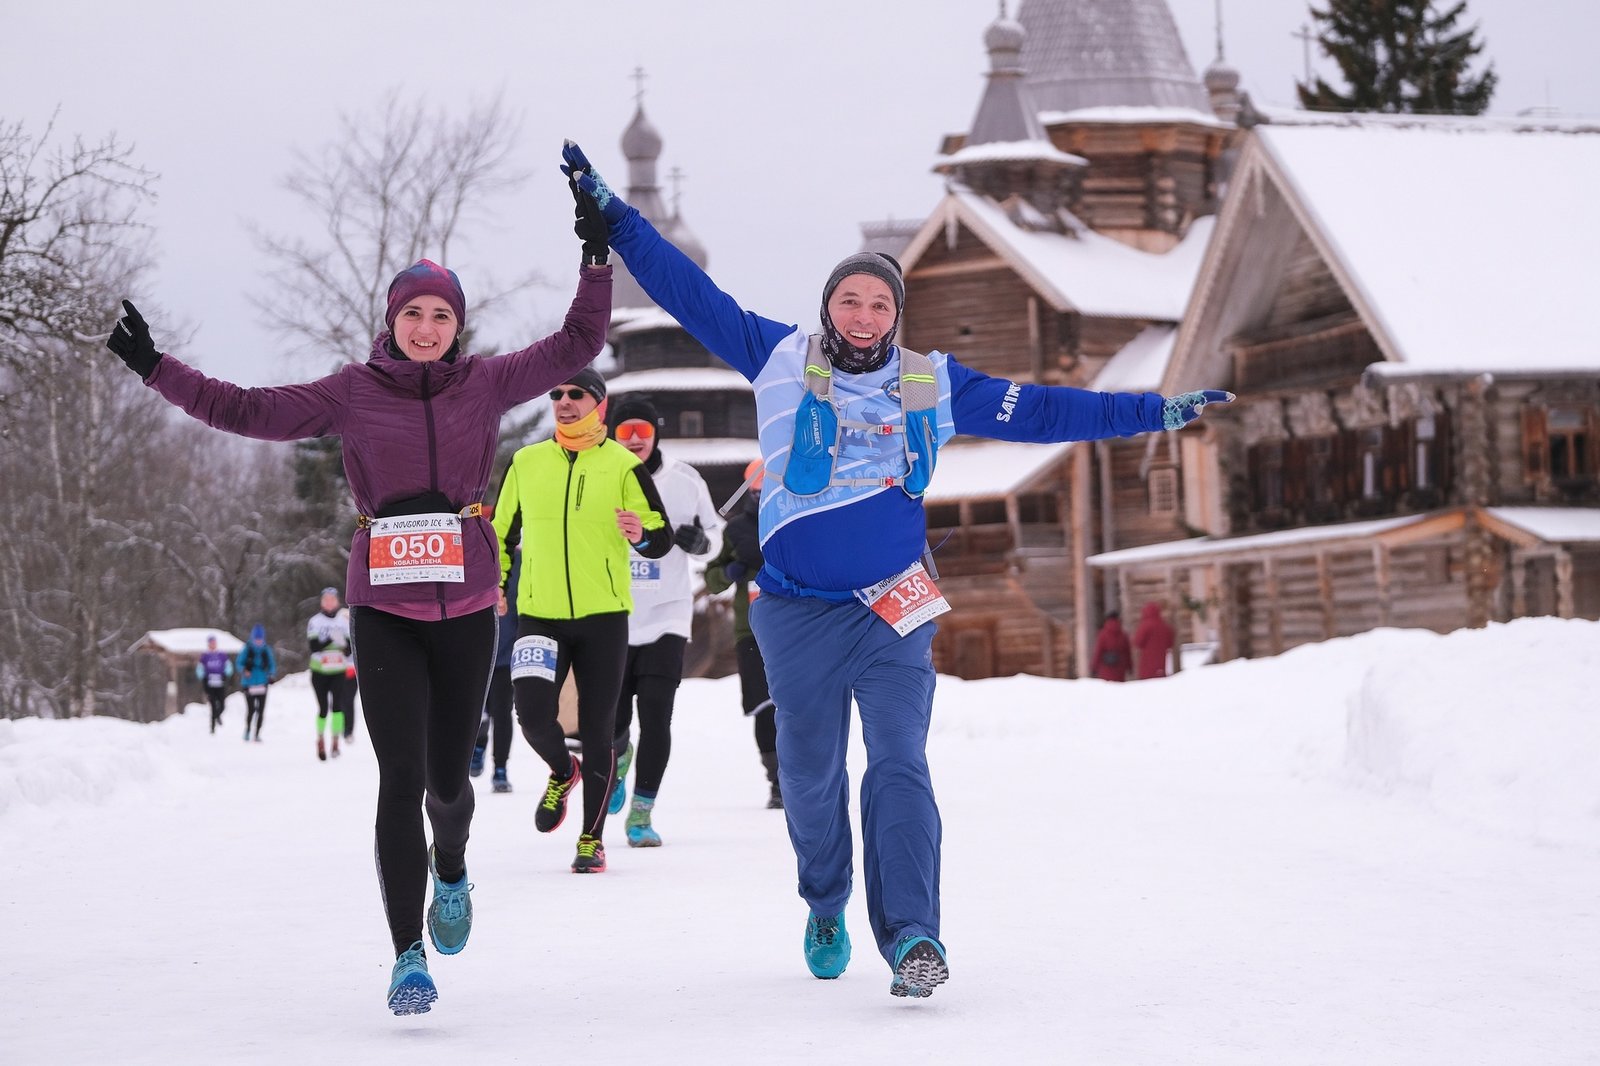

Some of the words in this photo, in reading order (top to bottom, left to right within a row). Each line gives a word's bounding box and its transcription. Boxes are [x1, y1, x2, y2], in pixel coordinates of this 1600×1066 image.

[996, 381, 1022, 423] SAIN
[393, 519, 429, 530] NOVGOROD
[430, 518, 442, 527] ICE
[389, 534, 445, 560] 050
[393, 559, 420, 567] КОВАЛЬ
[889, 575, 929, 609] 136
[513, 648, 545, 666] 188
